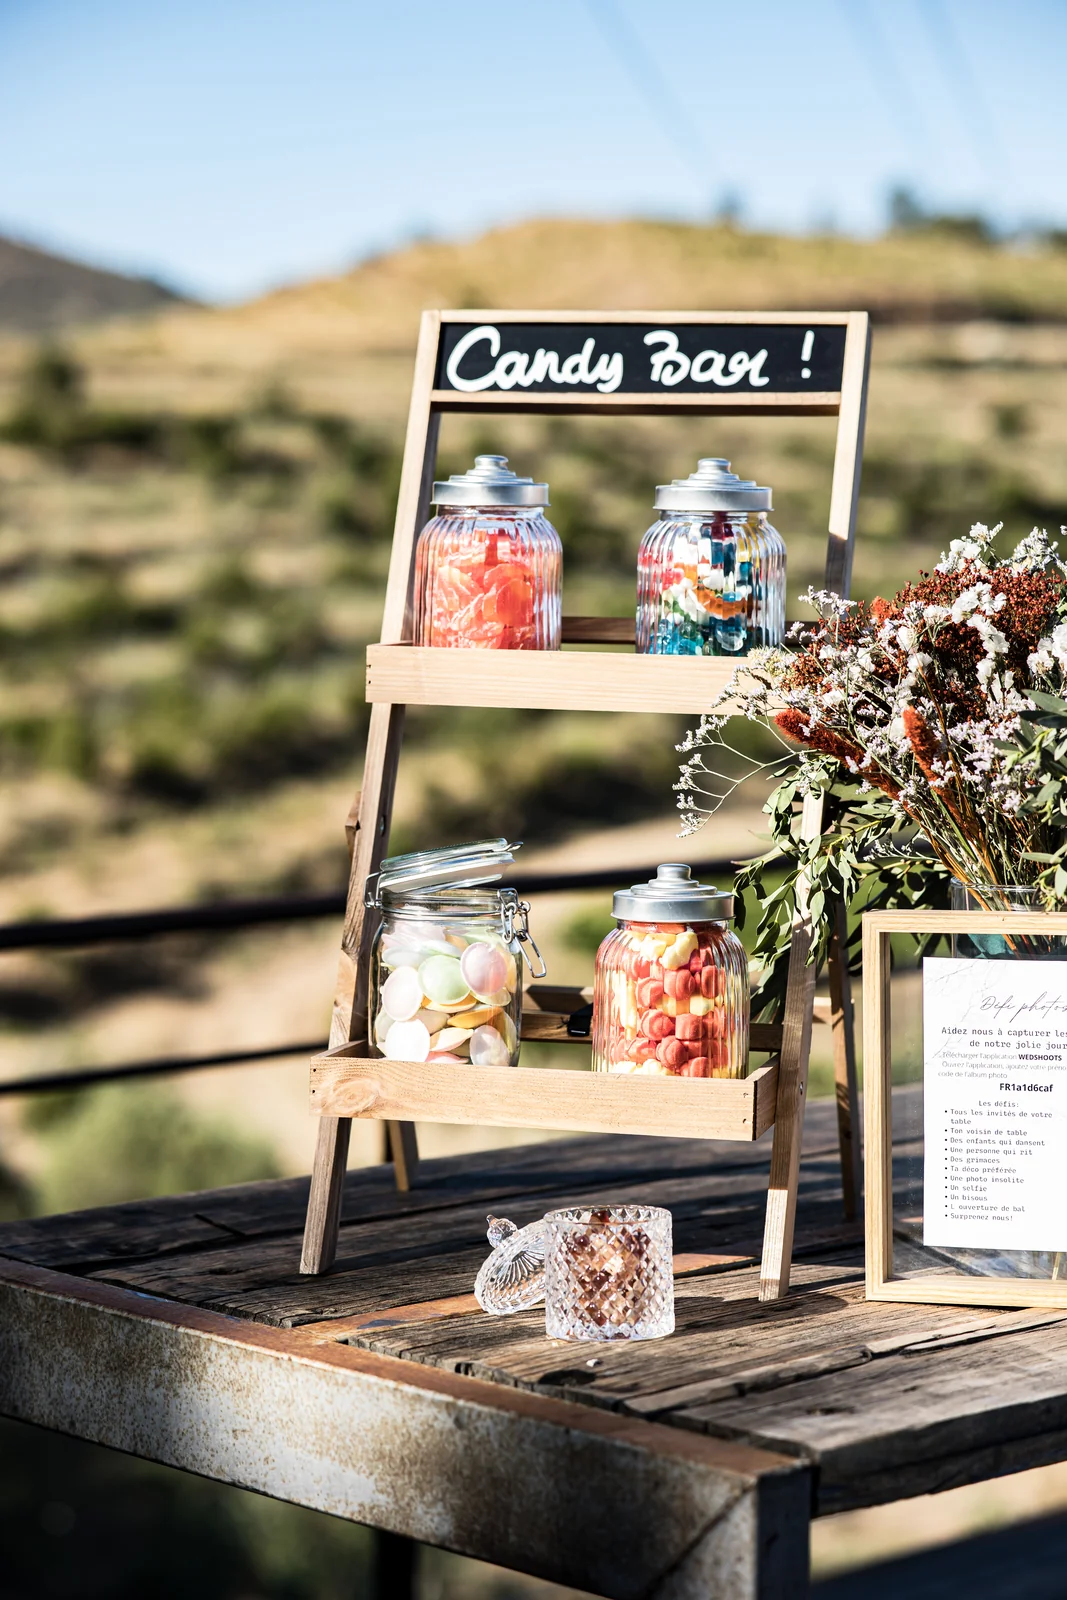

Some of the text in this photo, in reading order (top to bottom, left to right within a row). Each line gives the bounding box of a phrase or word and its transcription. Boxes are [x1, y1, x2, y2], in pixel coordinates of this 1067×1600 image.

[446, 325, 815, 393] Candy Bar !
[942, 1027, 967, 1035] Aidez
[1008, 1029, 1051, 1037] capturer
[1016, 1041, 1041, 1049] jolie
[1000, 1083, 1053, 1092] FR1a1d6caf
